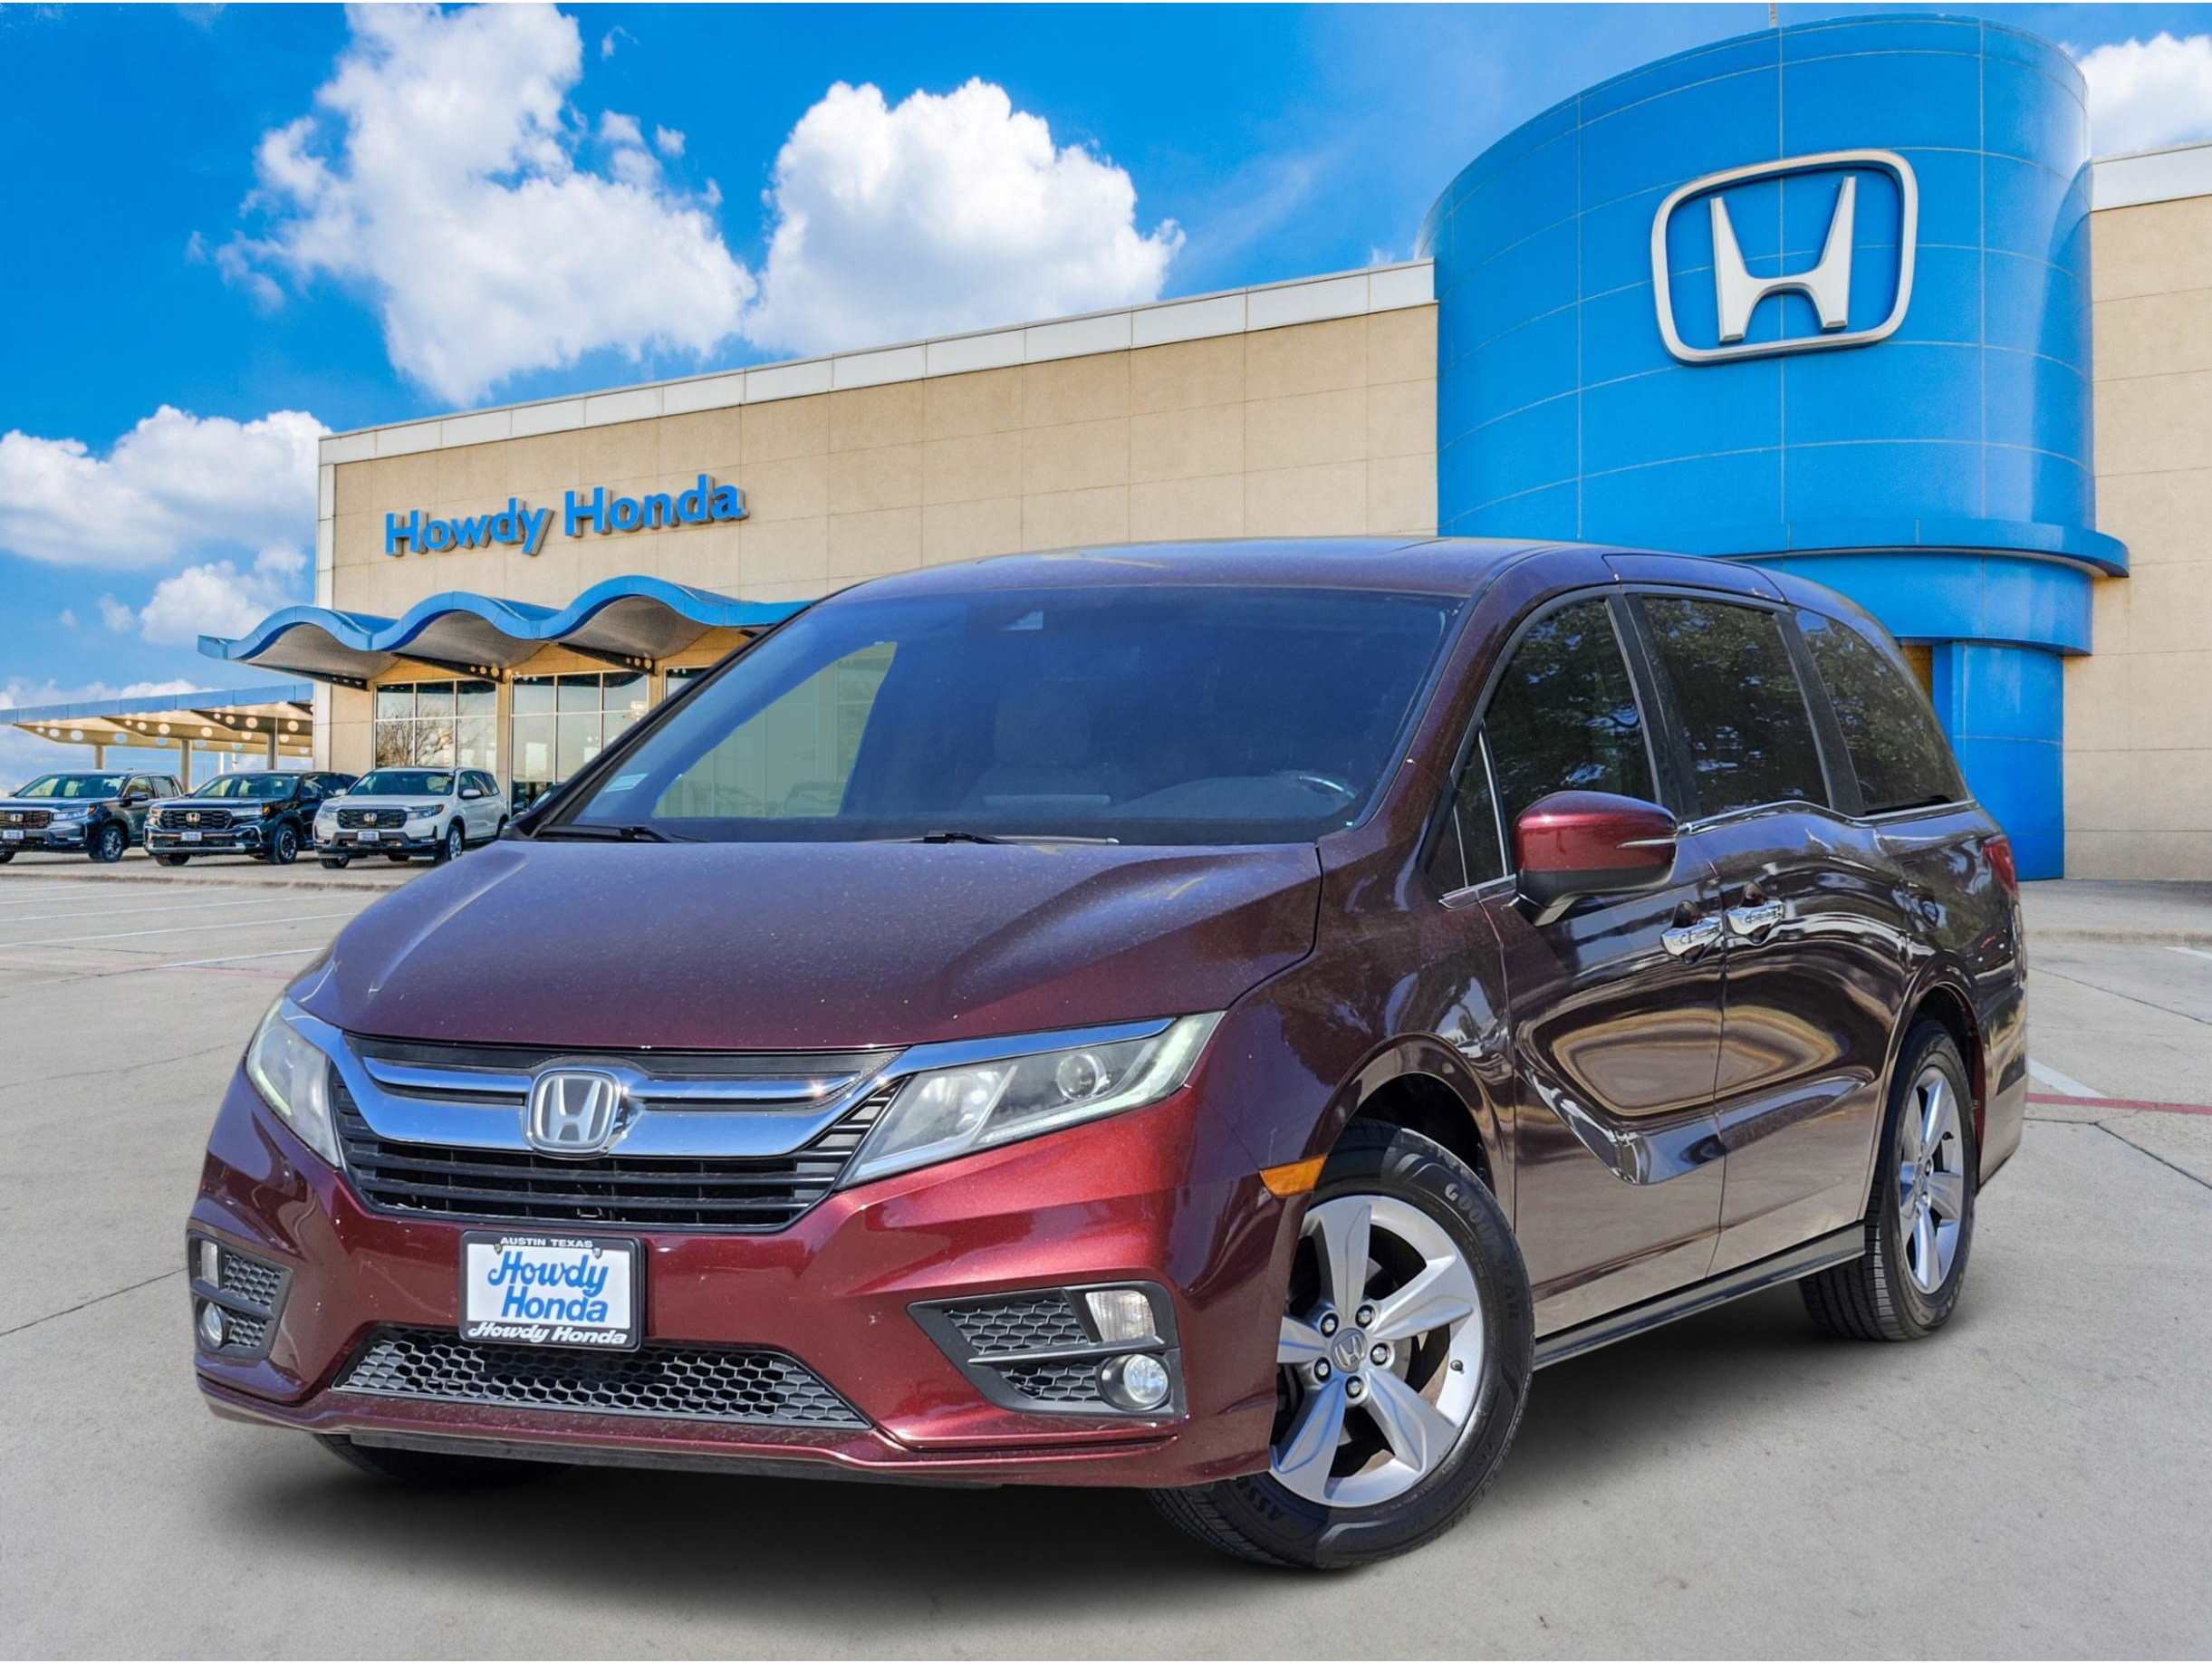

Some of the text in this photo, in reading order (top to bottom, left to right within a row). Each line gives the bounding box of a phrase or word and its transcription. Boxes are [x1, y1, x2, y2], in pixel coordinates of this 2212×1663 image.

[385, 474, 748, 557] Howdy Honda
[500, 1236, 594, 1248] AUSTIN TEXAS
[1444, 1181, 1520, 1319] GOODAR
[487, 1251, 610, 1297] Howdy
[501, 1285, 609, 1322] Honda
[467, 1322, 629, 1344] Howdy Honda
